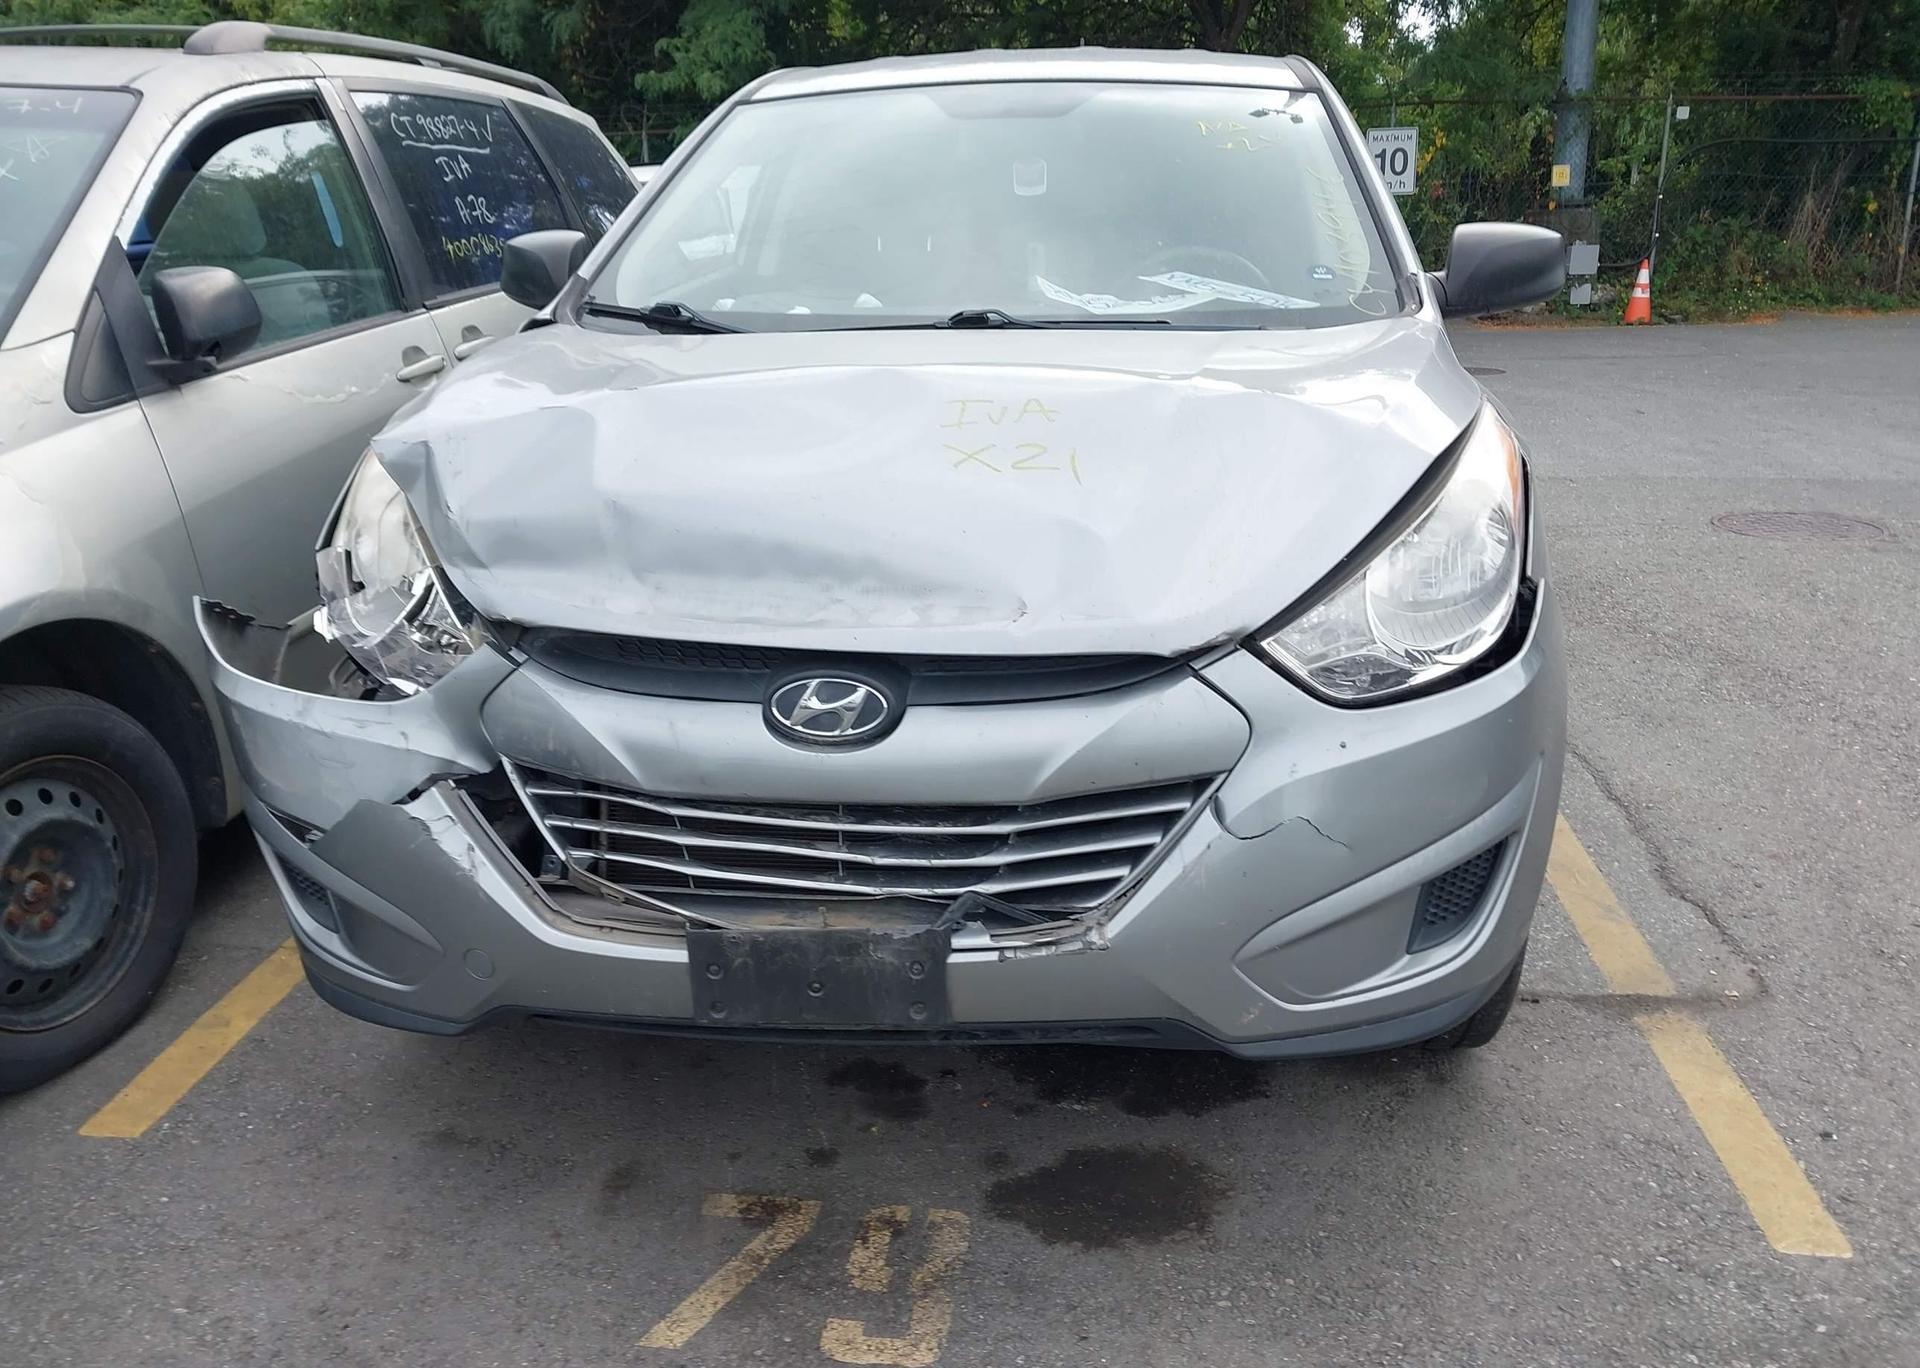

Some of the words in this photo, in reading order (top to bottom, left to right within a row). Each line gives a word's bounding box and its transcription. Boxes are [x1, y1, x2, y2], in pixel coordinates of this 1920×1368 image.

[390, 112, 415, 138] CT
[1372, 133, 1413, 143] MAXIMUM
[435, 154, 472, 182] IVA
[1374, 146, 1409, 177] 10
